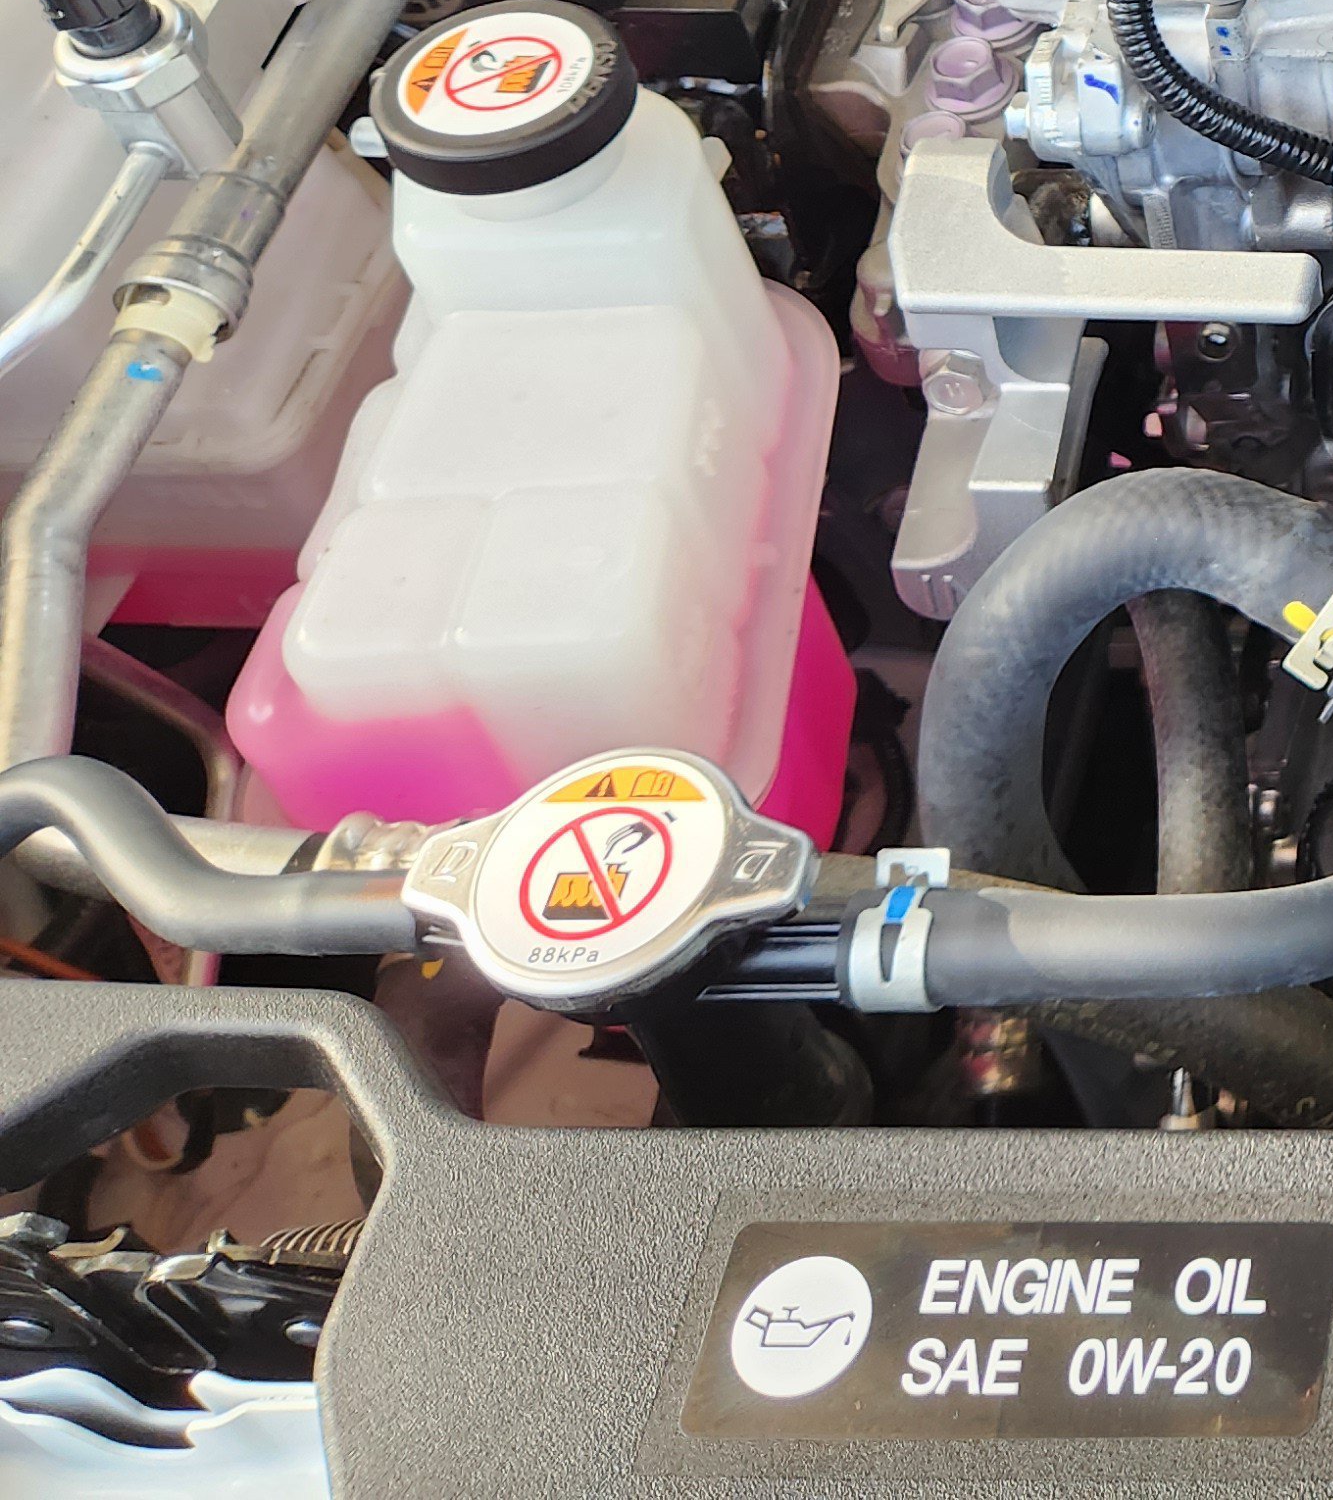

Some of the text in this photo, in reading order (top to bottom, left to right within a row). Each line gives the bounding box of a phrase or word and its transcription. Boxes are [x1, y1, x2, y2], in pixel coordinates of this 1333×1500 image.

[528, 946, 600, 964] 88kPa
[919, 1257, 1267, 1315] ENGINE OIL
[901, 1337, 1253, 1396] SAE 0W-20
